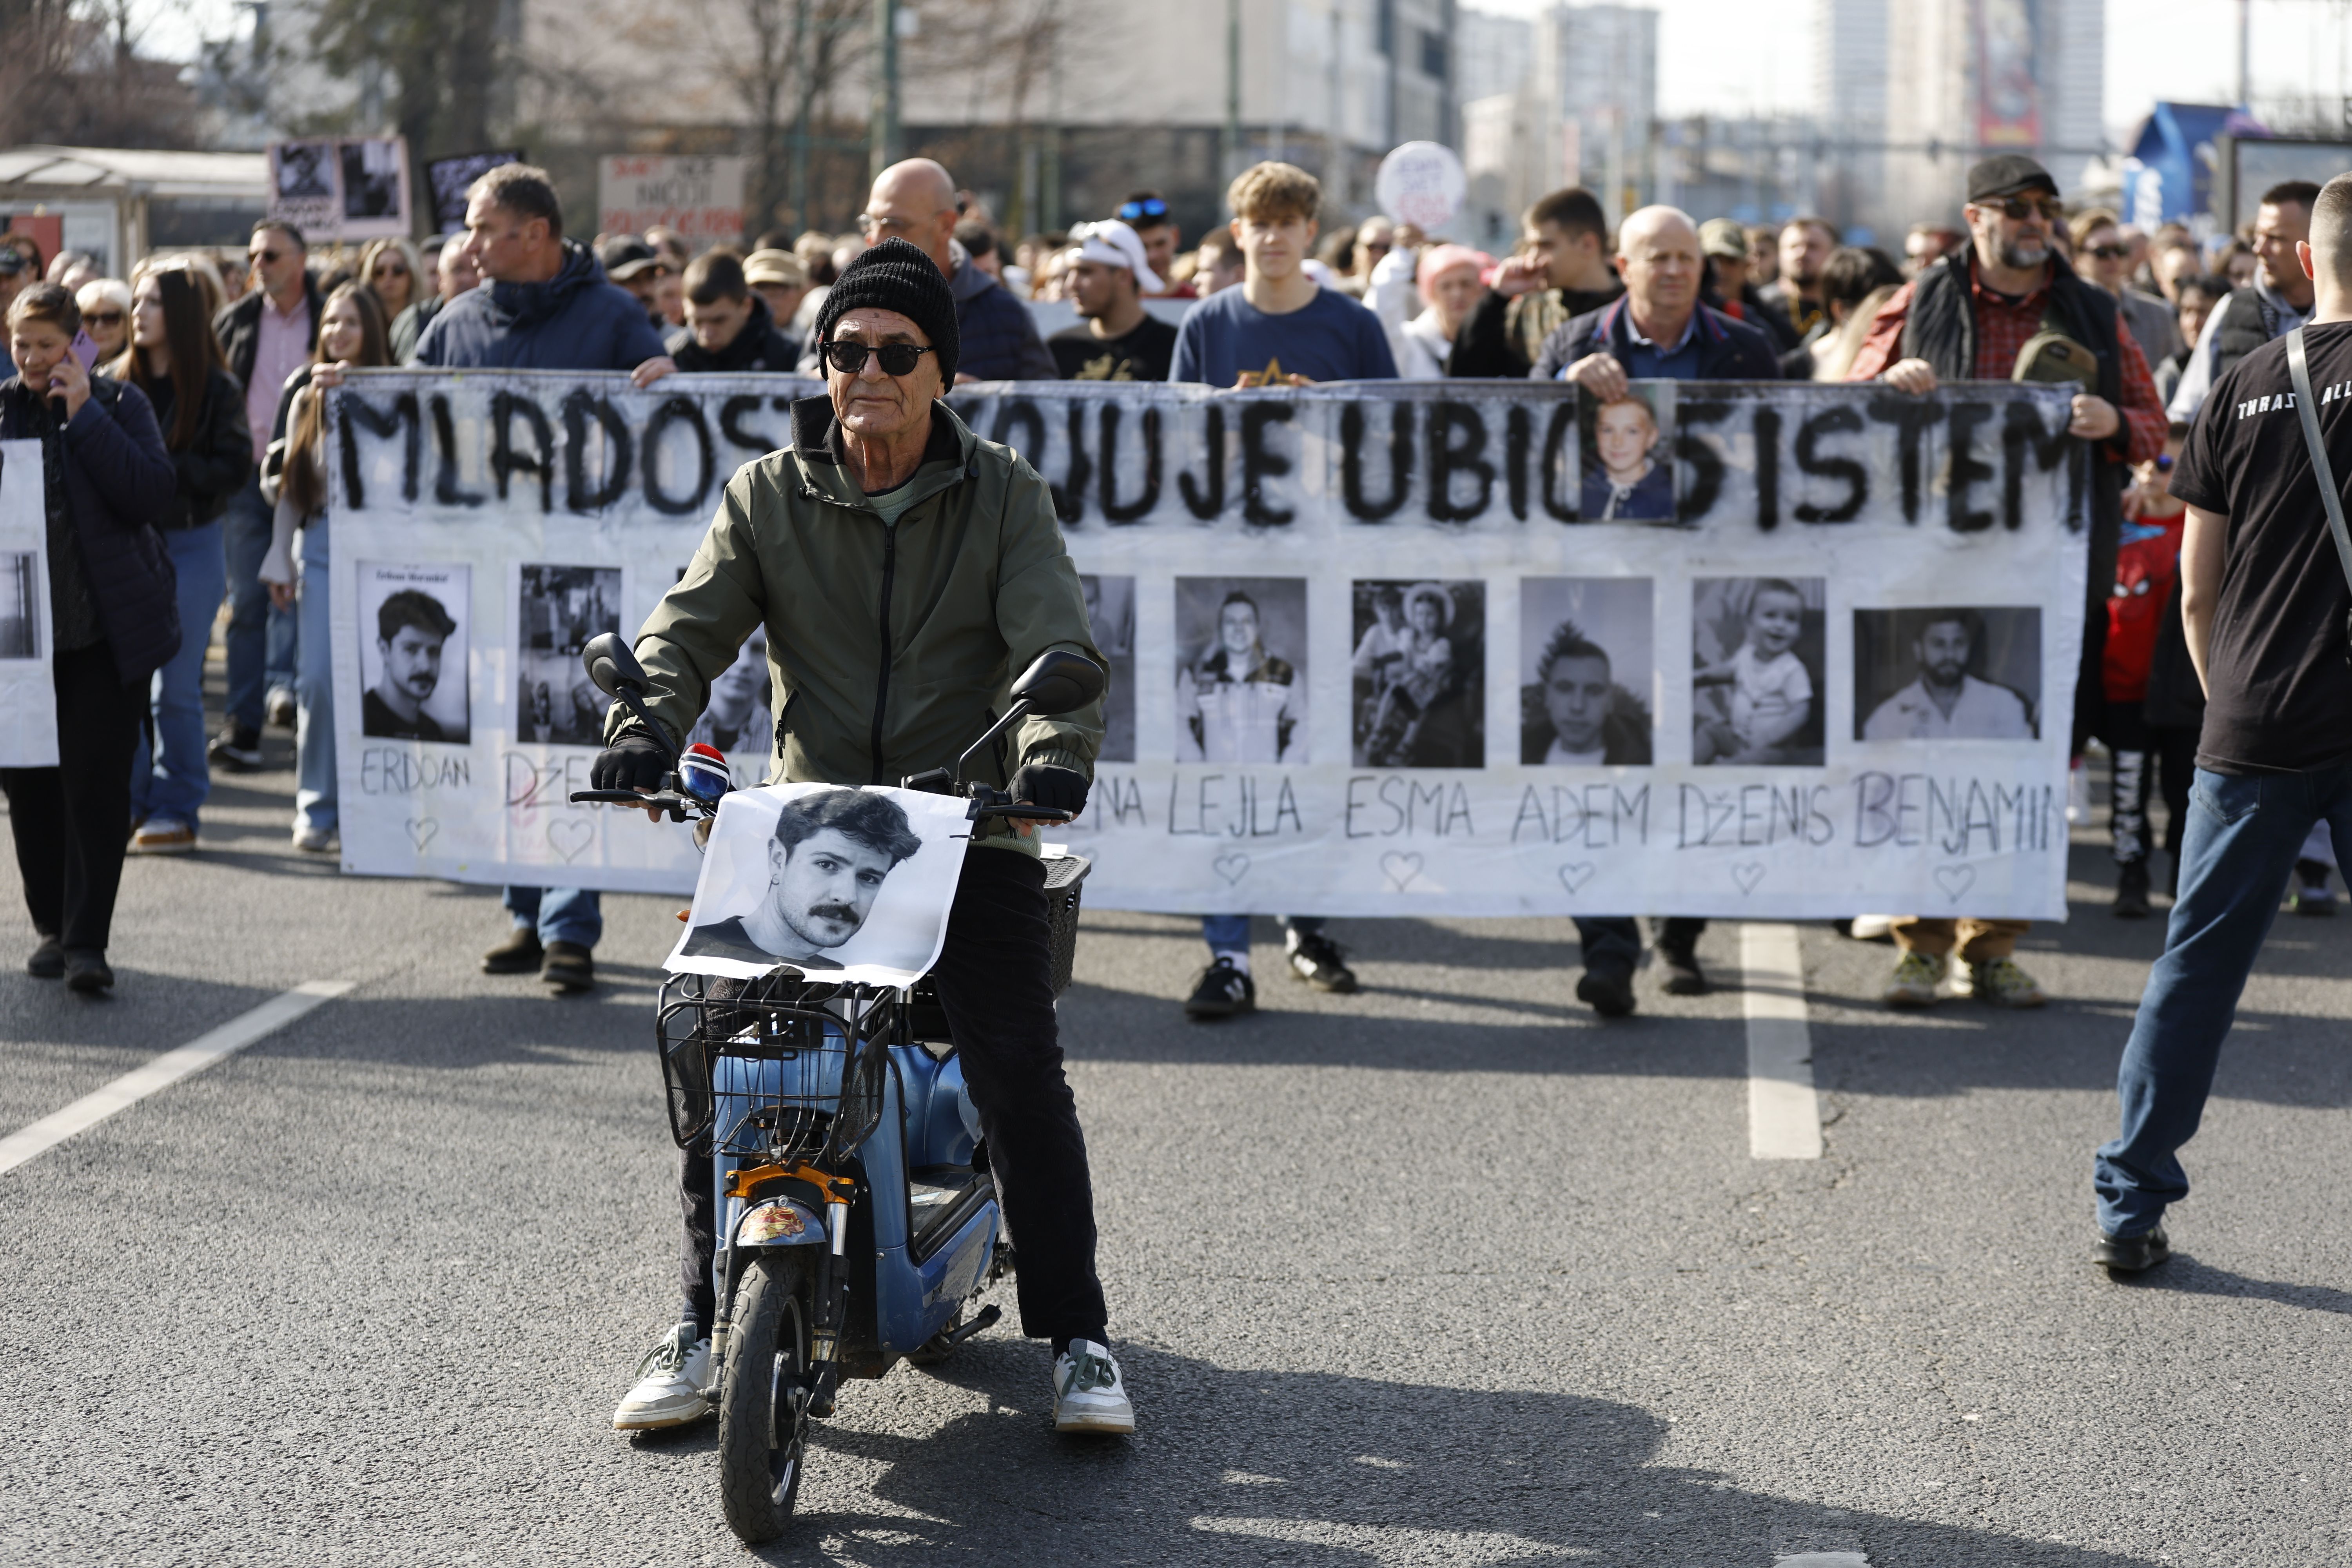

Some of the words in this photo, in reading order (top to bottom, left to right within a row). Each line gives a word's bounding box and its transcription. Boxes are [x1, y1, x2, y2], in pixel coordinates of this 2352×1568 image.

[335, 386, 790, 517] MLADOS
[2238, 392, 2297, 420] THRAS
[361, 746, 470, 796] ERDOAN
[1168, 773, 1302, 837] LEJLA
[1346, 775, 1475, 839] ESMA
[1510, 783, 1651, 848] ADEM
